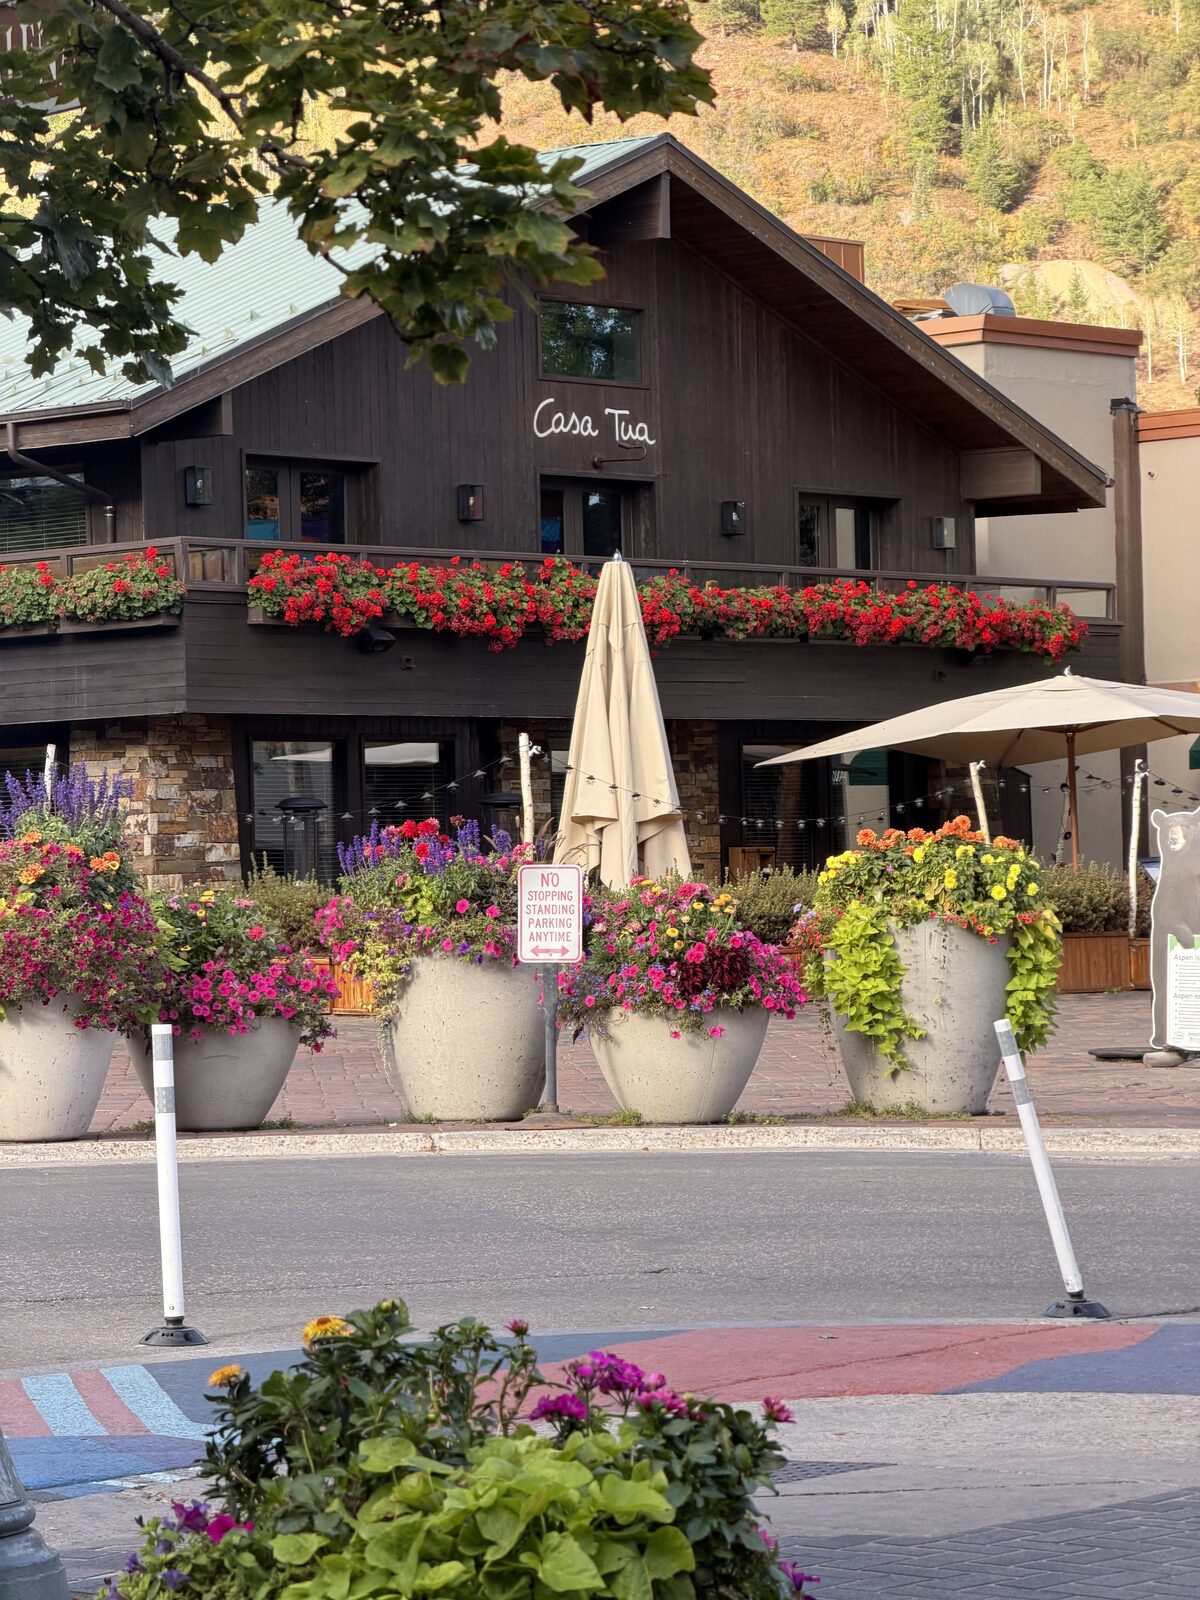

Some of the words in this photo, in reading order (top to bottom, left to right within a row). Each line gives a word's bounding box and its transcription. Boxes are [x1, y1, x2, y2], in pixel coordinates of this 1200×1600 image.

[533, 398, 599, 438] Casa
[604, 408, 656, 445] Tua
[540, 872, 560, 888] NO
[527, 890, 573, 902] STOPPING
[525, 904, 575, 915] STANDING
[528, 918, 572, 929] PARKING
[528, 931, 572, 942] ANYTIME
[1173, 954, 1193, 962] Aspen
[1173, 992, 1193, 1000] Aspen
